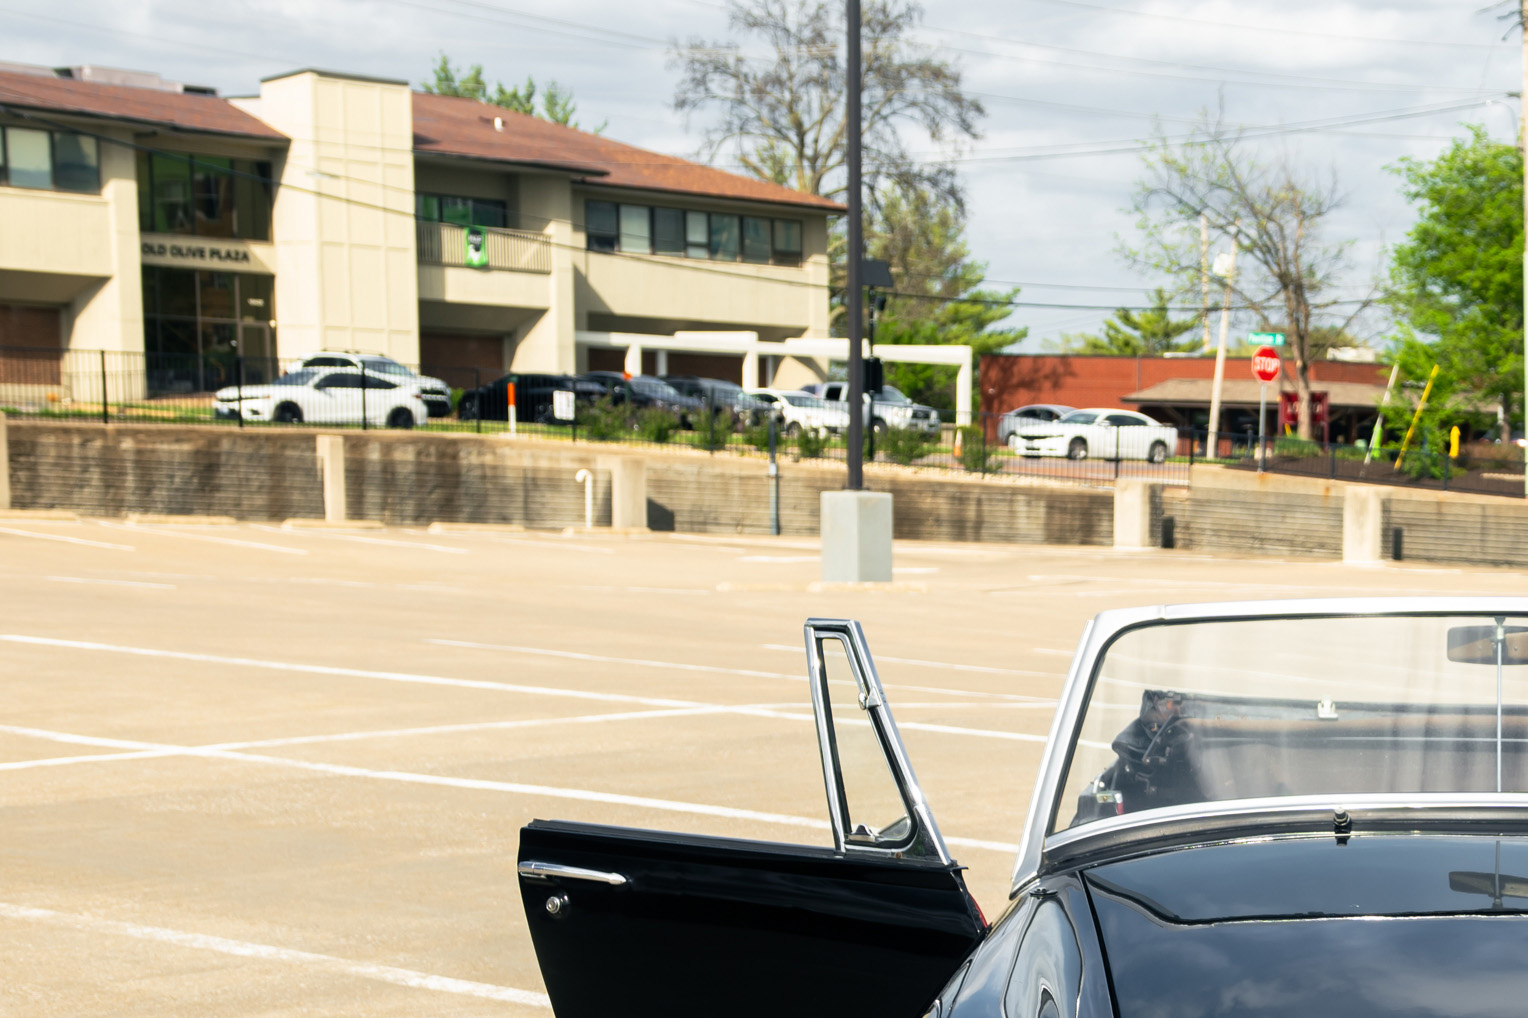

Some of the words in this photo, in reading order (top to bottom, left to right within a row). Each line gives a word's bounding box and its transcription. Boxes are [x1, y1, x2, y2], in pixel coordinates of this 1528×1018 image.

[142, 243, 167, 256] OLD
[170, 244, 206, 259] OLIVE
[209, 247, 250, 262] PLAZA
[1255, 356, 1281, 373] STOP
